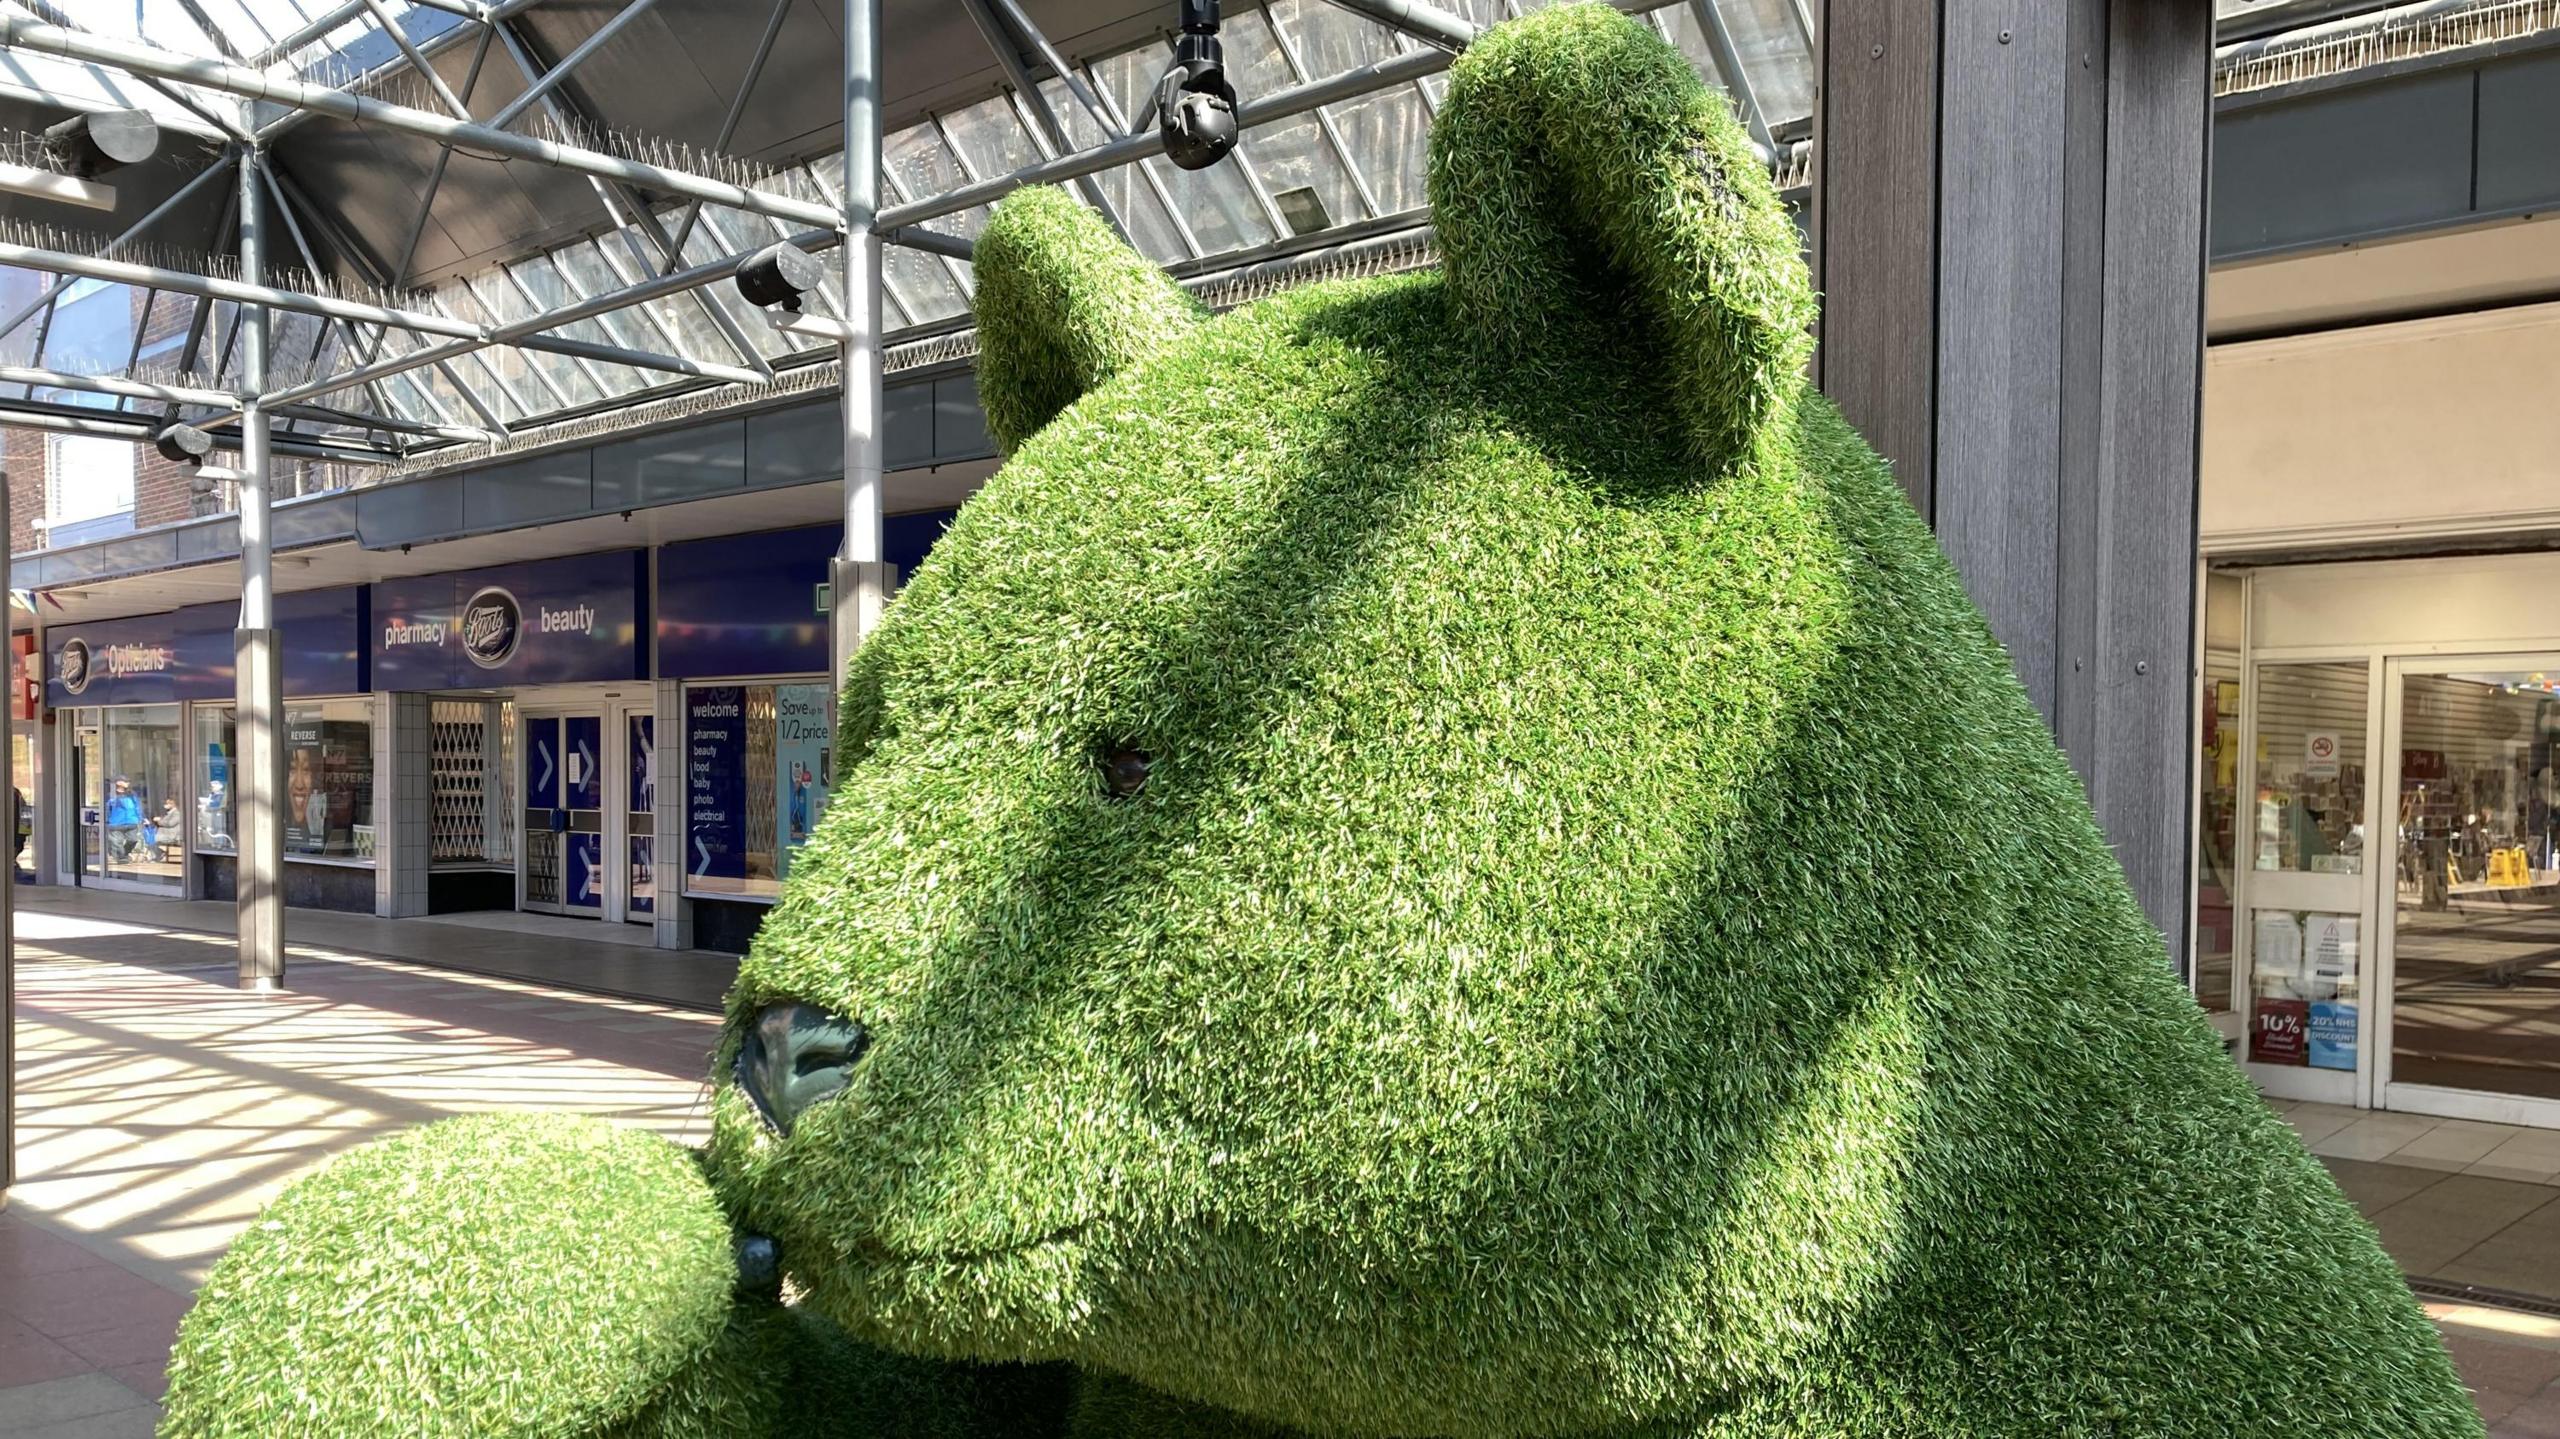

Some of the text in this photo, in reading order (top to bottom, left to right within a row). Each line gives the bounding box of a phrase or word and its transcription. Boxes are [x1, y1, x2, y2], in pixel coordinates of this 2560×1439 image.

[541, 603, 594, 635] beauty
[466, 605, 505, 648] Boots
[385, 621, 447, 650] pharmacy
[108, 642, 165, 678] Opticians
[693, 702, 739, 718] welcome
[781, 699, 809, 716] Save
[291, 730, 316, 741] REVERSE
[693, 729, 728, 742] pharmacy
[781, 720, 828, 744] 1/2 price
[693, 745, 717, 758] beauty
[693, 761, 710, 772] food
[693, 778, 711, 790] baby
[693, 794, 714, 805] photo
[693, 810, 725, 821] electrical
[2260, 1014, 2300, 1034] 10%
[2312, 1016, 2356, 1028] 20% NHS
[2311, 1032, 2355, 1043] DISCOUNT
